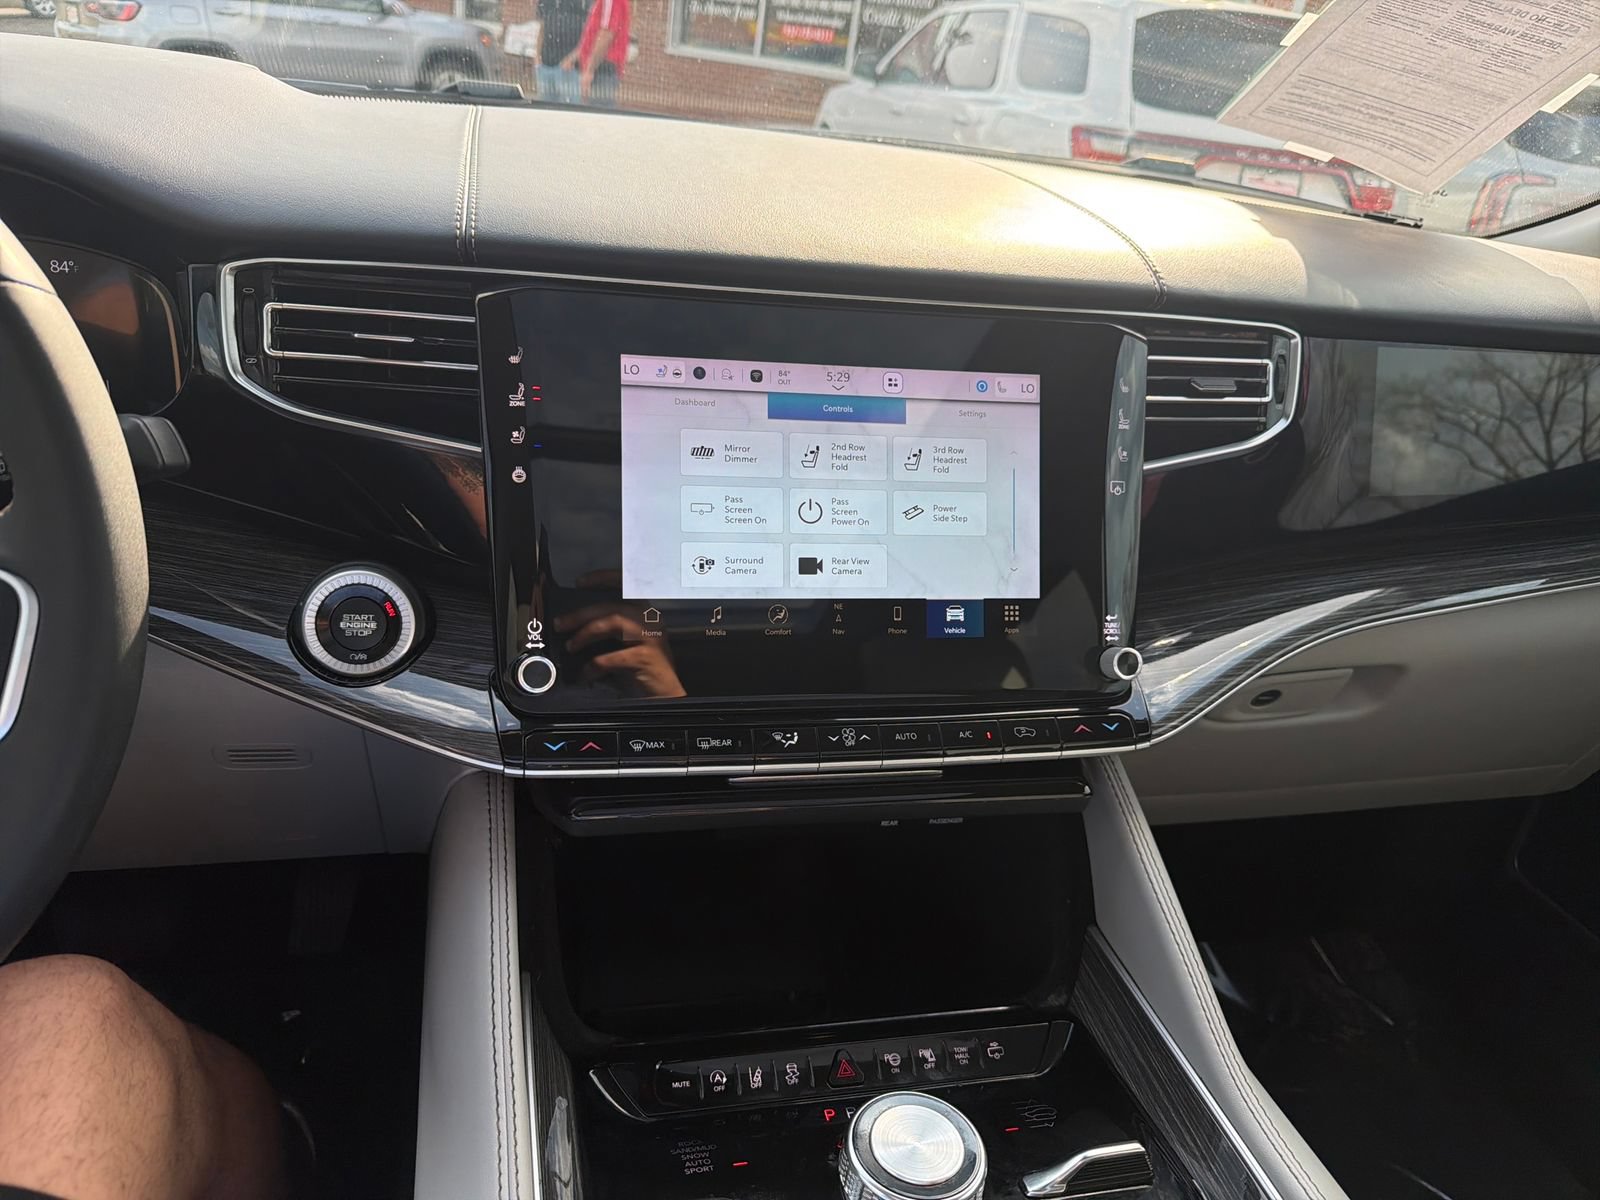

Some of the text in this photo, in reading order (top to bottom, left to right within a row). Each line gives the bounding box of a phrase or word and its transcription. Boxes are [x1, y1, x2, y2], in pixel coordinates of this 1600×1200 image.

[624, 364, 640, 375] LO
[826, 371, 851, 383] 5:29
[1021, 383, 1035, 394] LO
[674, 397, 716, 407] Dashboard
[822, 404, 854, 413] Controls
[958, 409, 987, 419] Settings
[724, 444, 751, 454] Mirror
[831, 443, 866, 452] 2nd Row
[933, 446, 965, 454] 3rd Row
[724, 454, 758, 464] Dimmer
[831, 452, 867, 462] Headrest
[933, 455, 968, 465] Headrest
[831, 463, 849, 471] Fold
[933, 466, 950, 474] Fold
[724, 495, 744, 504] Pass
[831, 497, 849, 506] Pass
[724, 505, 753, 514] Screen
[831, 508, 859, 516] Screen
[933, 504, 958, 513] Power
[724, 516, 768, 525] Screen On
[831, 518, 870, 527] Power On
[933, 514, 969, 525] Side Step
[724, 556, 765, 565] Surround
[831, 557, 871, 566] Rear View
[724, 567, 758, 576] Camera
[831, 567, 863, 576] Camera
[384, 601, 396, 617] RUN
[340, 621, 378, 629] ENGINE
[345, 629, 373, 637] STOP
[764, 628, 792, 636] Comfort
[887, 627, 908, 635] Phone
[1004, 627, 1020, 636] Apps
[895, 732, 917, 741] AUTO
[959, 730, 974, 739] A/C
[646, 741, 665, 749] MAX
[711, 738, 732, 747] REAR
[672, 1080, 691, 1088] MUTE
[750, 1081, 762, 1089] OFF
[824, 1109, 836, 1121] P
[681, 1151, 710, 1161] SNOW
[685, 1158, 712, 1168] AUTO
[684, 1165, 714, 1175] SPORT
